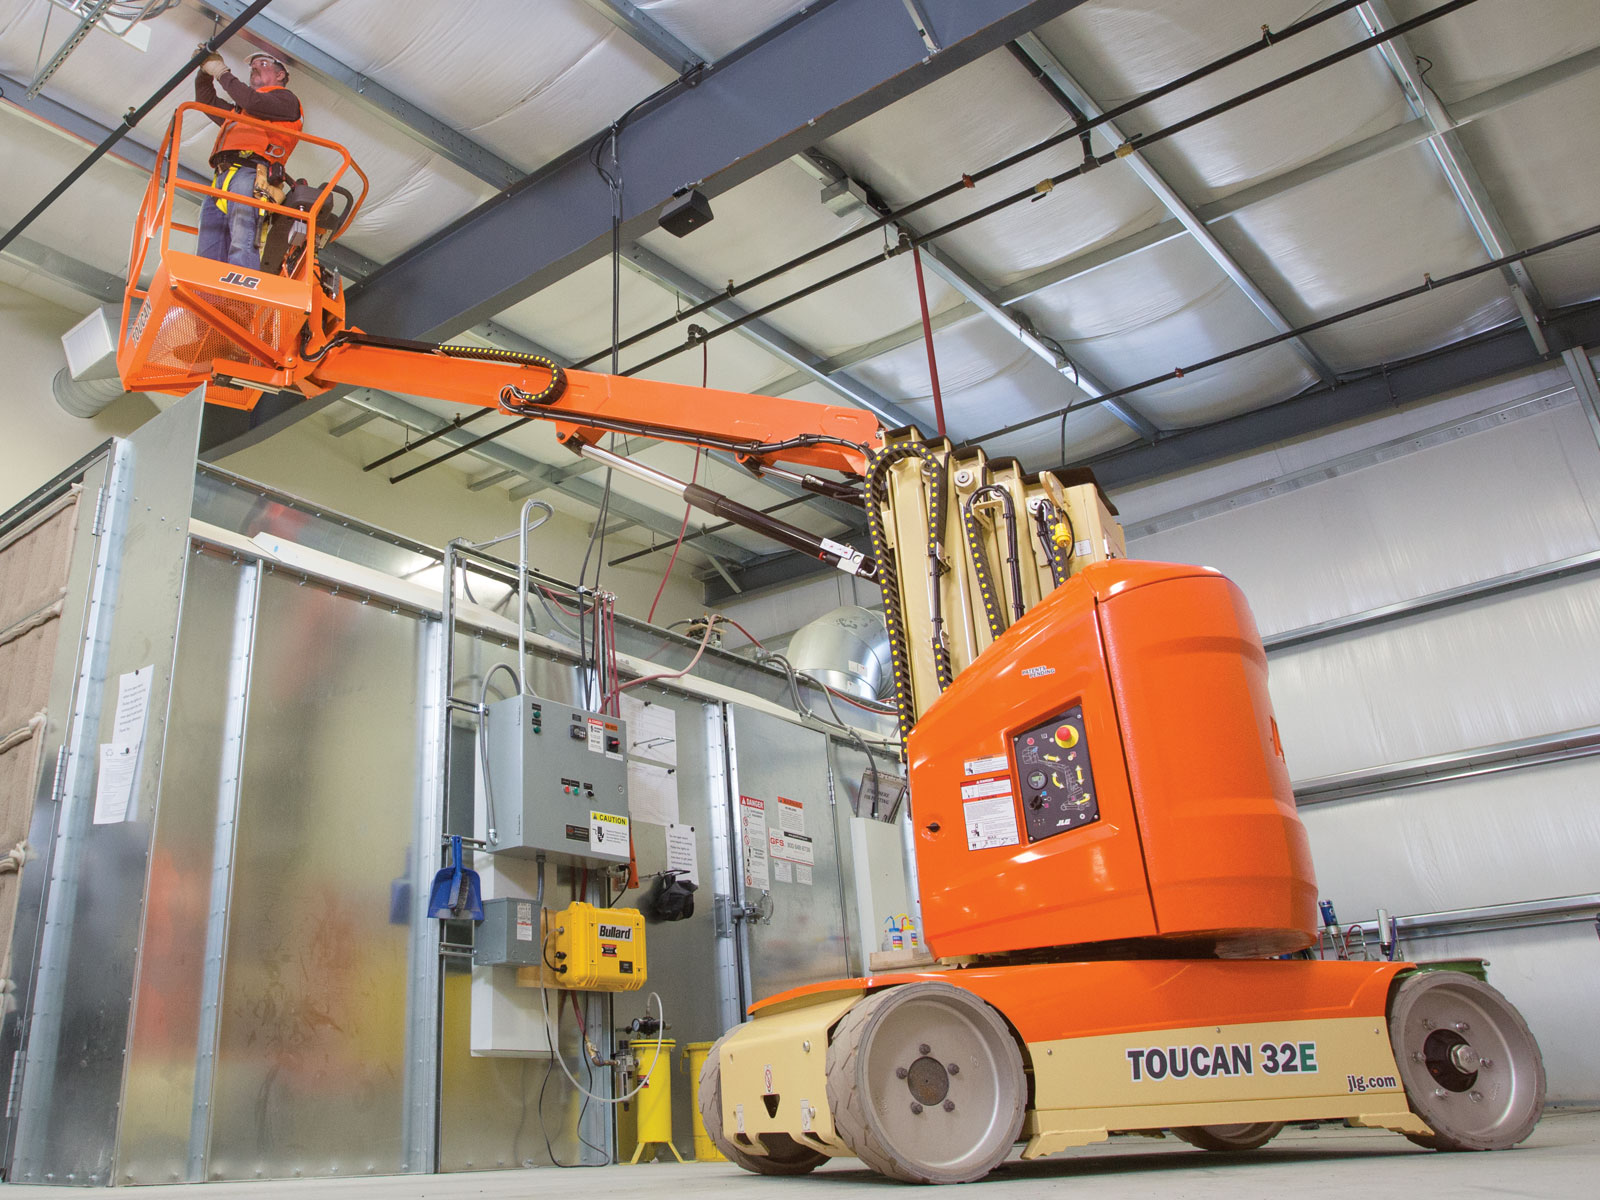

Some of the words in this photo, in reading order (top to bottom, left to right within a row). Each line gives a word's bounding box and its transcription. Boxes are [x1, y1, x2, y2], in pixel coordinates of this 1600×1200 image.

[220, 272, 260, 289] JLG
[132, 296, 152, 348] TOUCAN
[1022, 666, 1046, 675] PATENTS
[1030, 669, 1055, 678] PENDING
[599, 814, 626, 825] CAUTION
[769, 837, 785, 847] GFS
[599, 925, 631, 940] Bullard
[1126, 1044, 1253, 1081] TOUCAN
[1260, 1042, 1318, 1074] 32E
[1347, 1075, 1397, 1092] jlg.com
